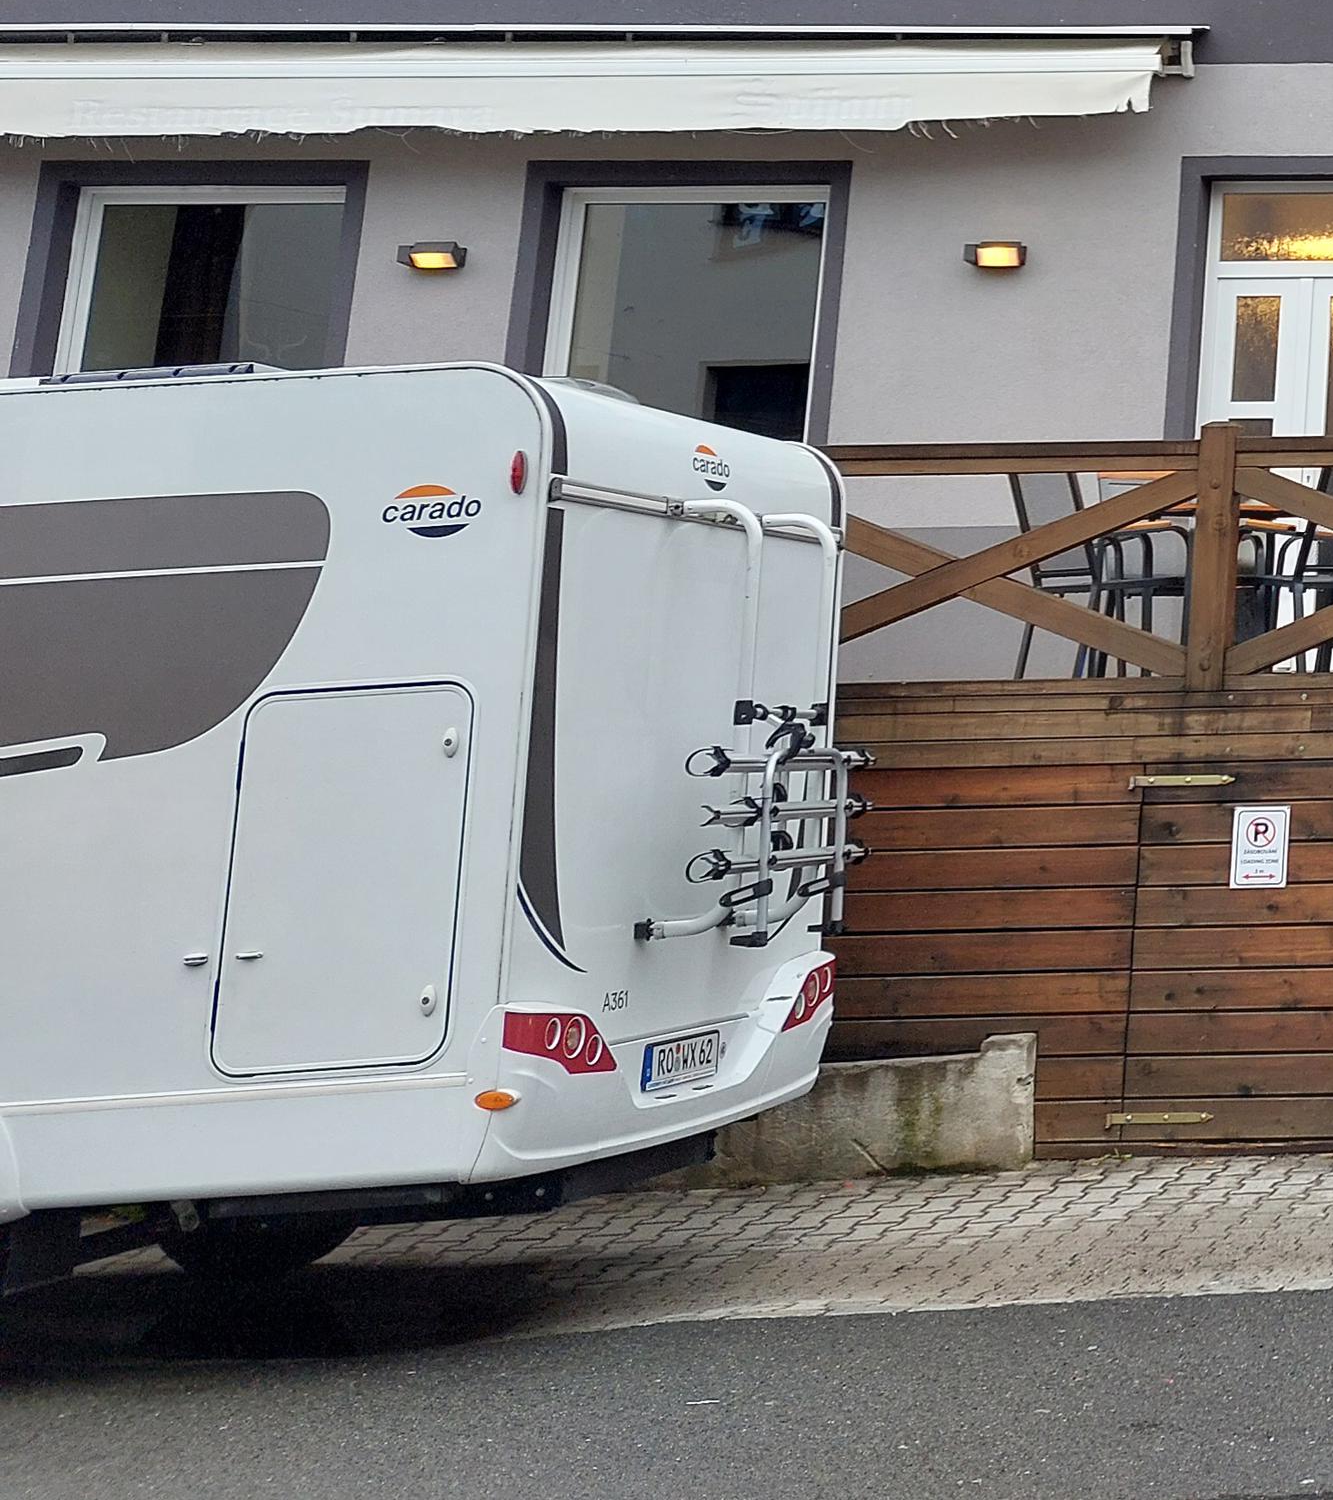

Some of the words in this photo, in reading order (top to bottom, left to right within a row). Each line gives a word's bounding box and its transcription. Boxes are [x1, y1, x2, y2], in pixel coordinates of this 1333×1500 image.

[692, 457, 730, 478] carado
[382, 495, 482, 523] carado
[602, 989, 629, 1012] A361
[657, 1047, 674, 1076] RO
[698, 1038, 713, 1065] 62
